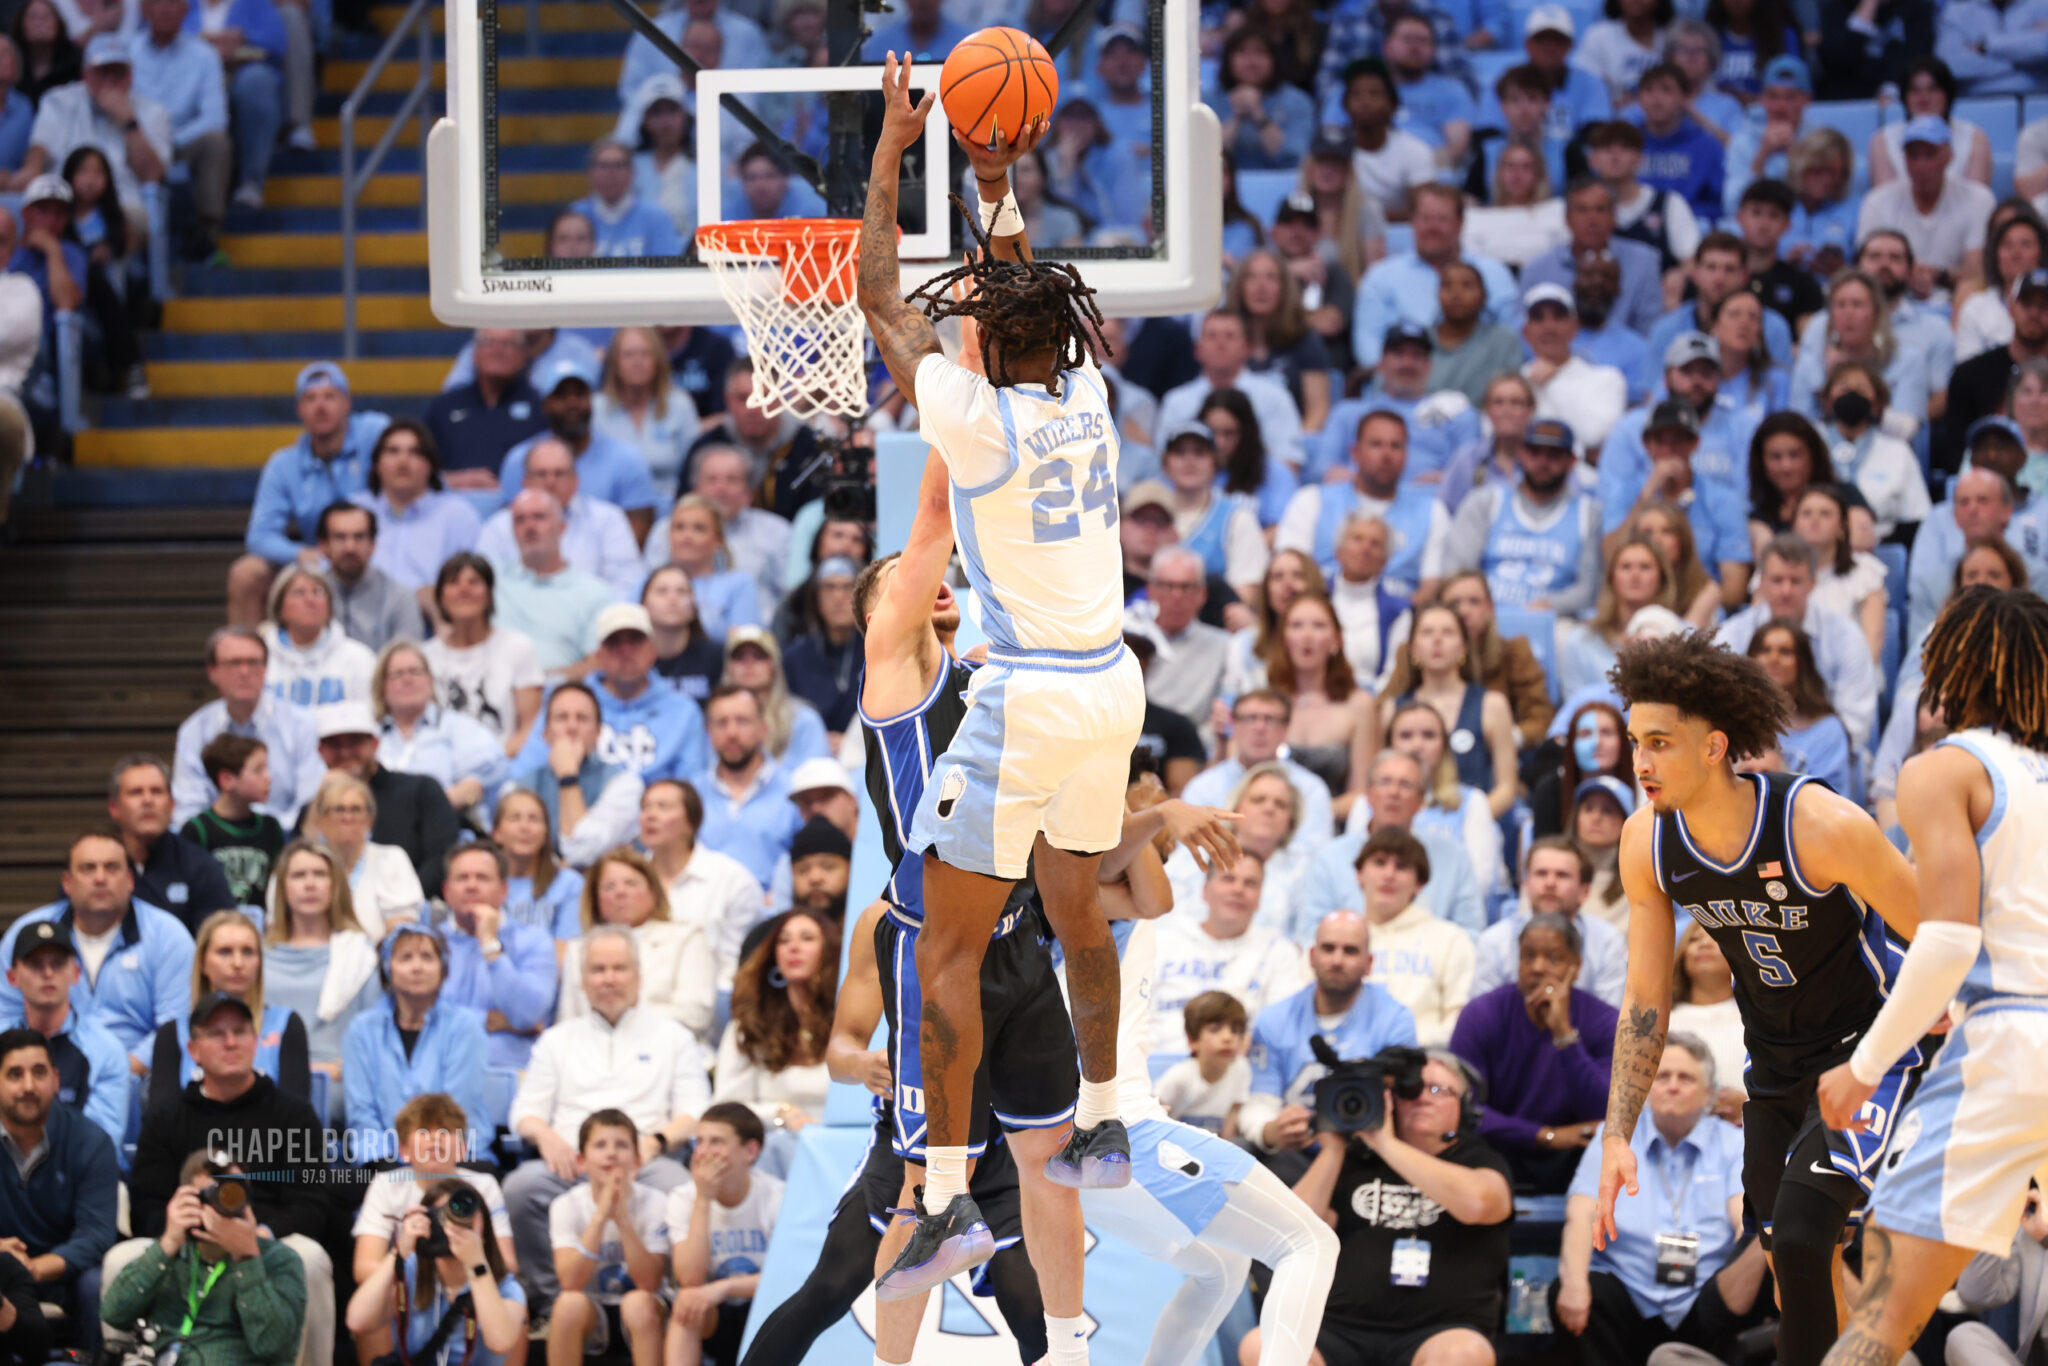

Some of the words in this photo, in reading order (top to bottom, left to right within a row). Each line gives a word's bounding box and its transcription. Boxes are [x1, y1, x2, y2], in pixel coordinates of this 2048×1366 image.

[481, 277, 553, 294] SPALDING
[1023, 411, 1105, 460] WITHERS
[1028, 442, 1119, 544] 24
[1682, 899, 1809, 931] DUKE
[1741, 929, 1799, 988] 5
